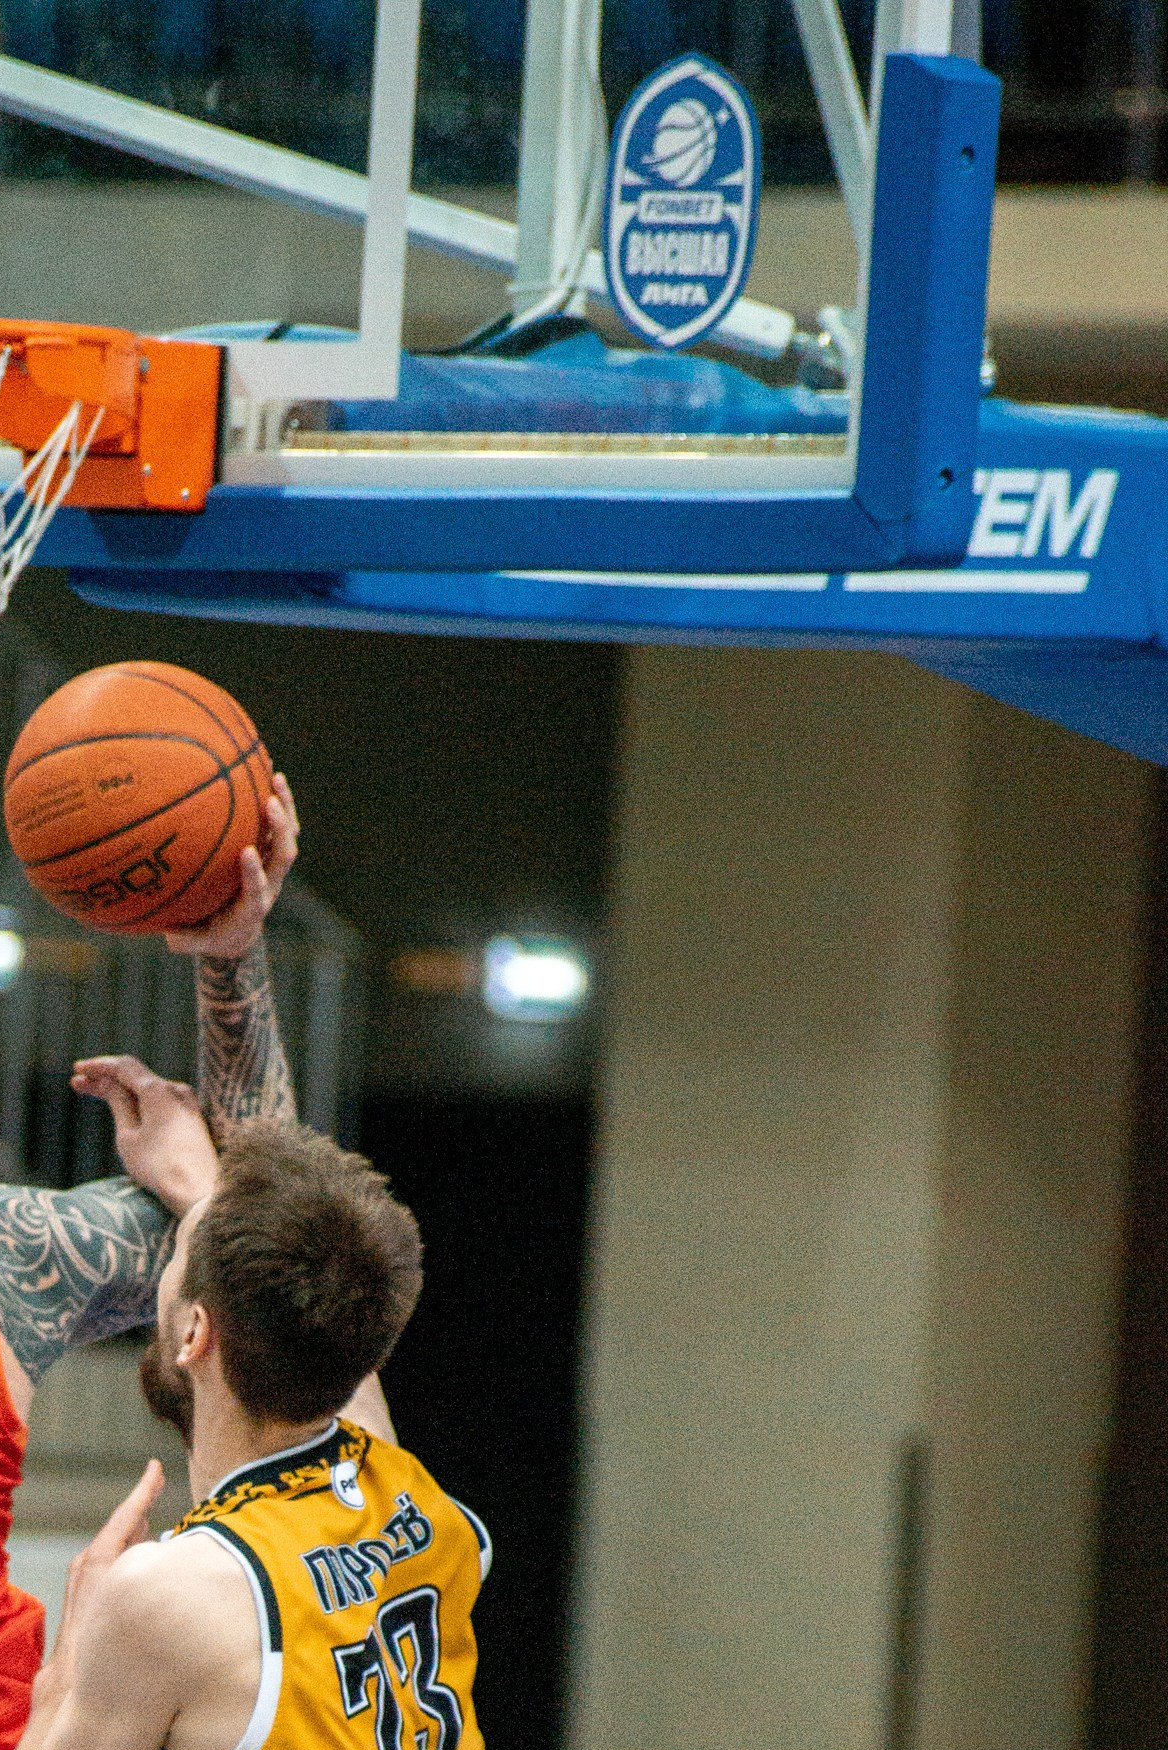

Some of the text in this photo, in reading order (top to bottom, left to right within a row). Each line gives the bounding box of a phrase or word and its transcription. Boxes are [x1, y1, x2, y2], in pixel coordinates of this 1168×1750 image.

[645, 199, 716, 217] FONBET
[626, 230, 729, 276] ВЫСШАЯ
[966, 467, 1120, 558] EM
